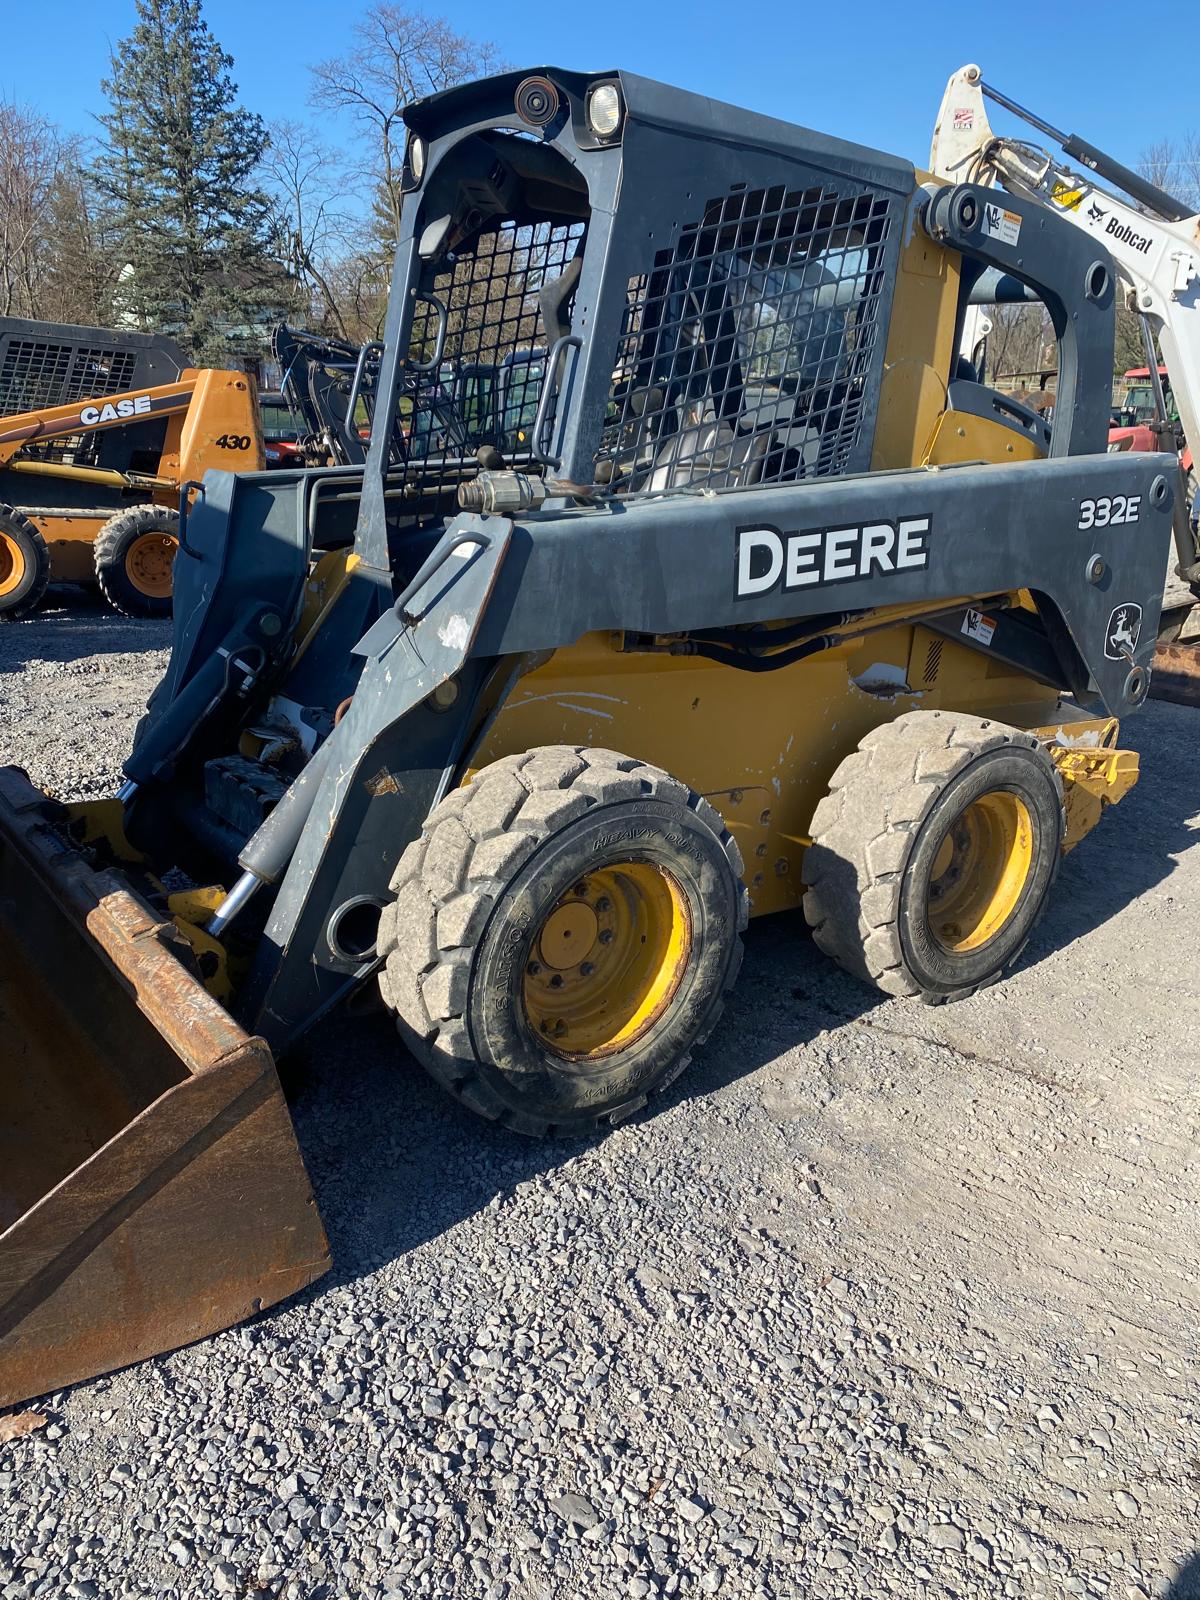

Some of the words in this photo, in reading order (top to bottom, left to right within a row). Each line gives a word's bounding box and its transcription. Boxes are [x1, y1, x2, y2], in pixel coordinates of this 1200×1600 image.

[1105, 217, 1153, 254] Bobcat
[80, 395, 151, 425] CASE
[215, 434, 252, 450] 430
[1078, 495, 1141, 530] 332E
[737, 518, 929, 596] DEERE
[592, 827, 661, 851] HEAVY
[664, 831, 706, 862] DUTY
[495, 911, 531, 1011] SAMSON
